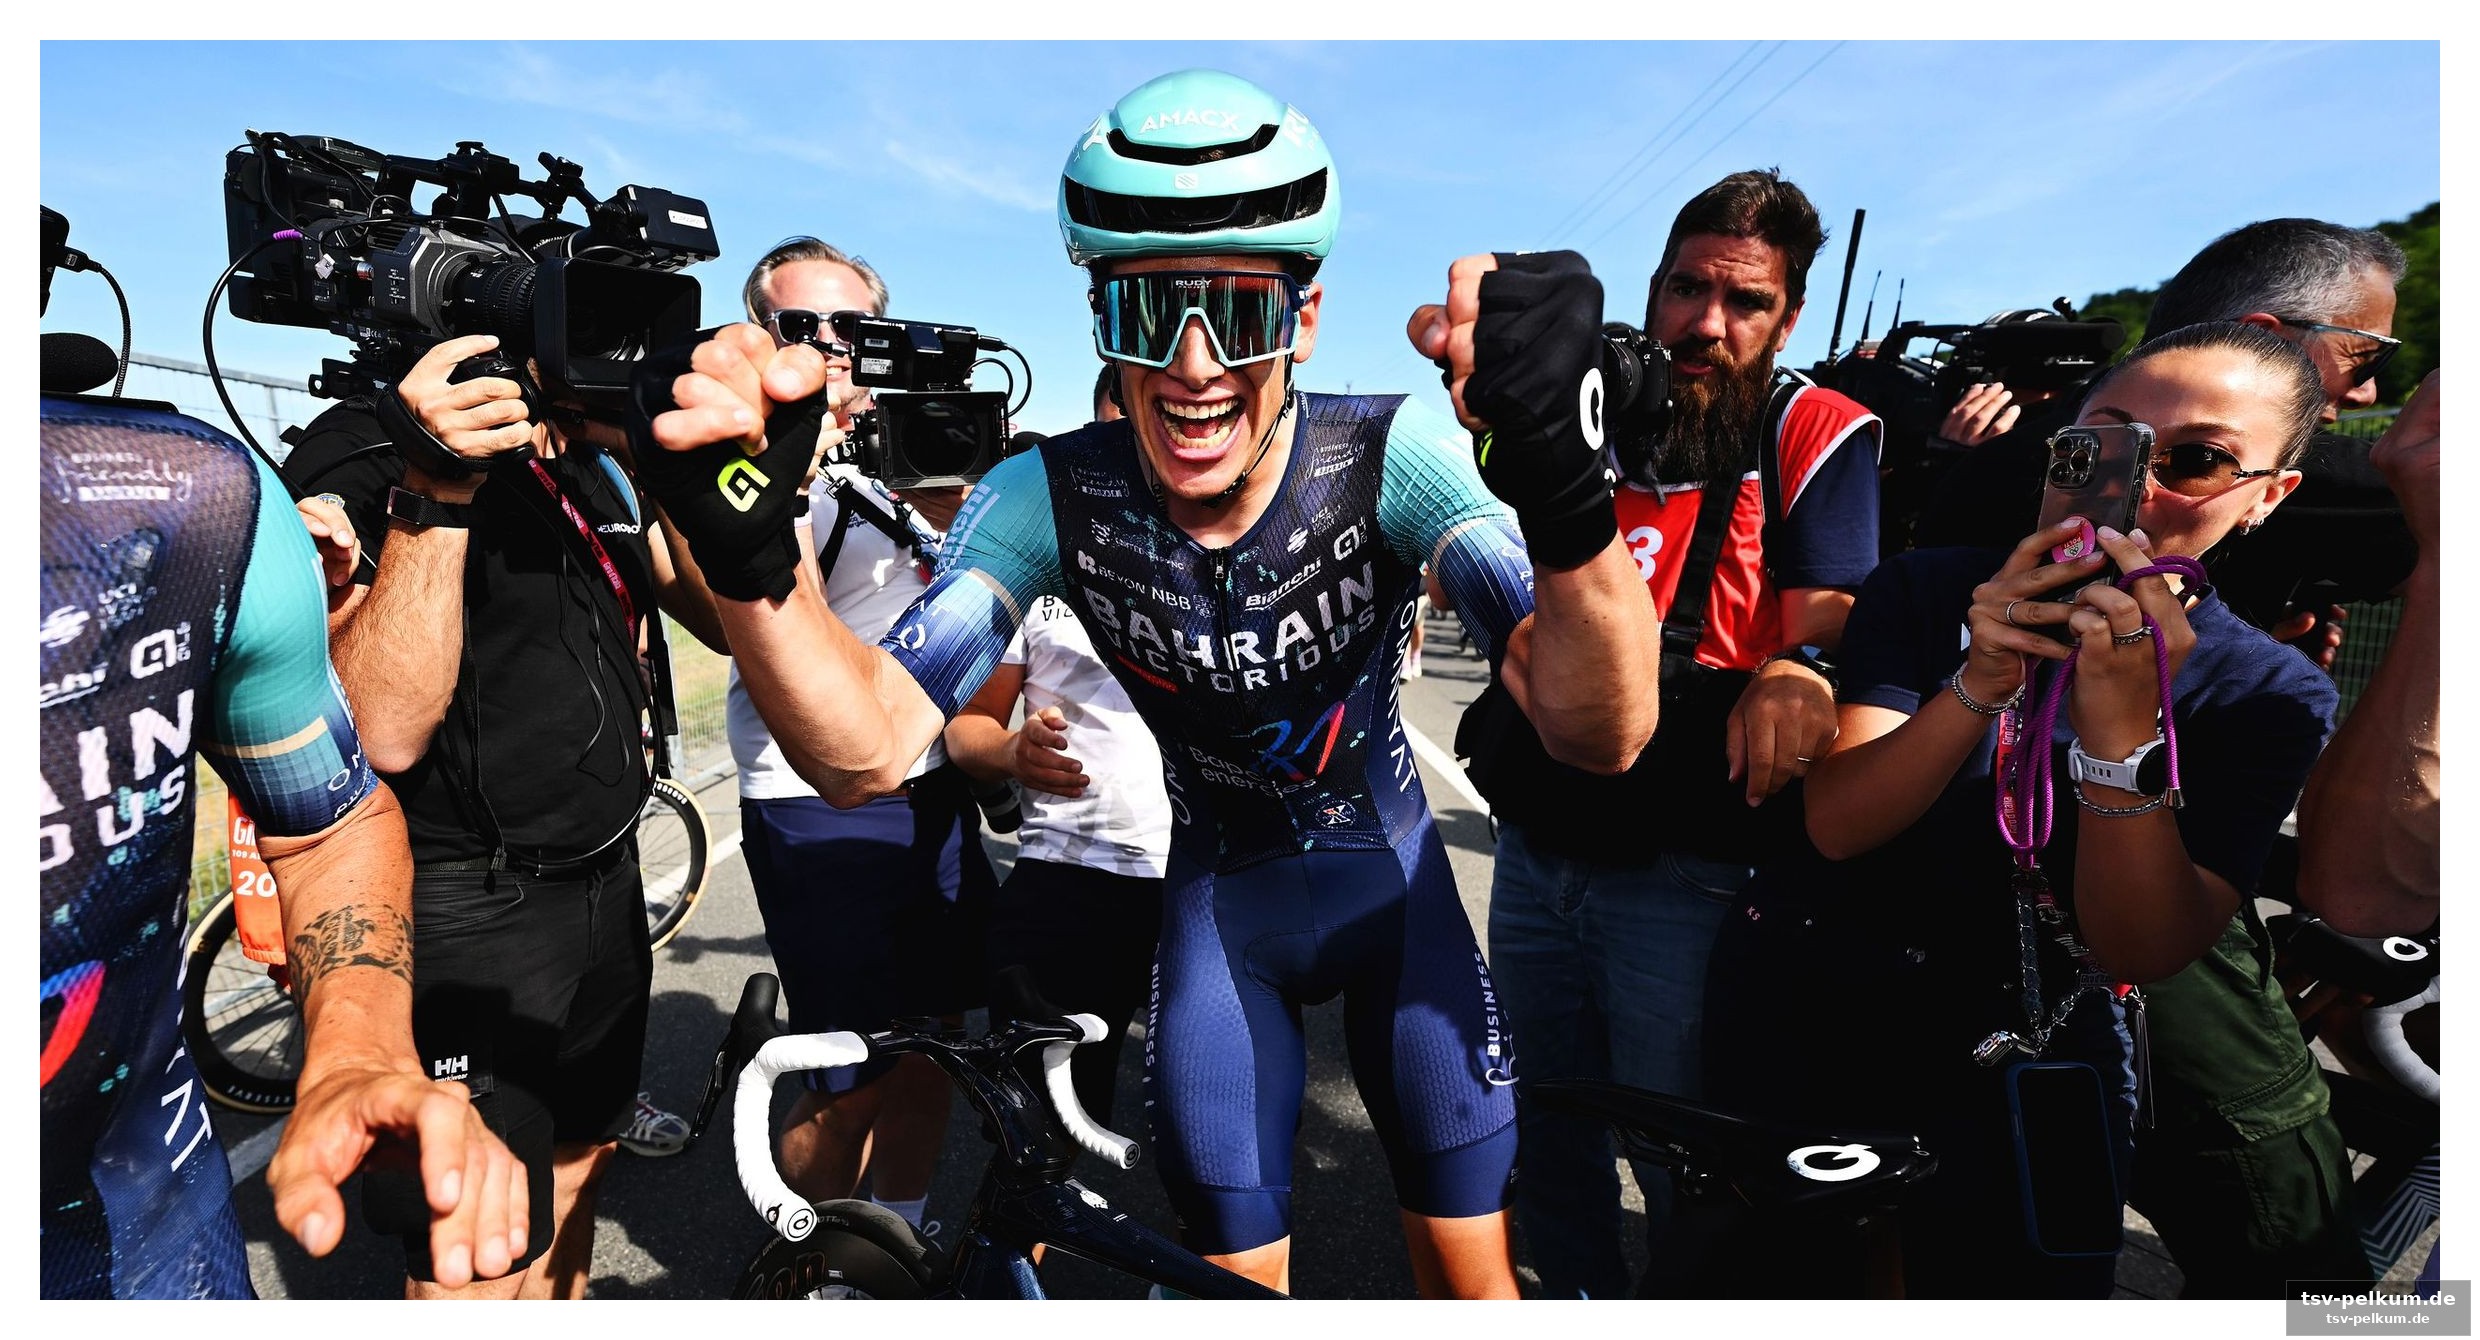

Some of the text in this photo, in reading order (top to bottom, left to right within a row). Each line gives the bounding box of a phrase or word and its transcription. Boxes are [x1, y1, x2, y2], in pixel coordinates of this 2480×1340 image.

[1140, 111, 1239, 133] AMACX
[1311, 506, 1328, 523] UCI
[1626, 526, 1664, 582] 3
[1043, 595, 1055, 608] B
[1151, 586, 1191, 610] NBB
[1245, 556, 1323, 608] Bianchi
[1042, 608, 1073, 621] VIC
[1083, 561, 1374, 671] BAHRAIN
[1100, 604, 1376, 693] VICTORIOUS
[1146, 963, 1160, 1067] BUSINESS
[1475, 952, 1501, 1057] BUSINESS
